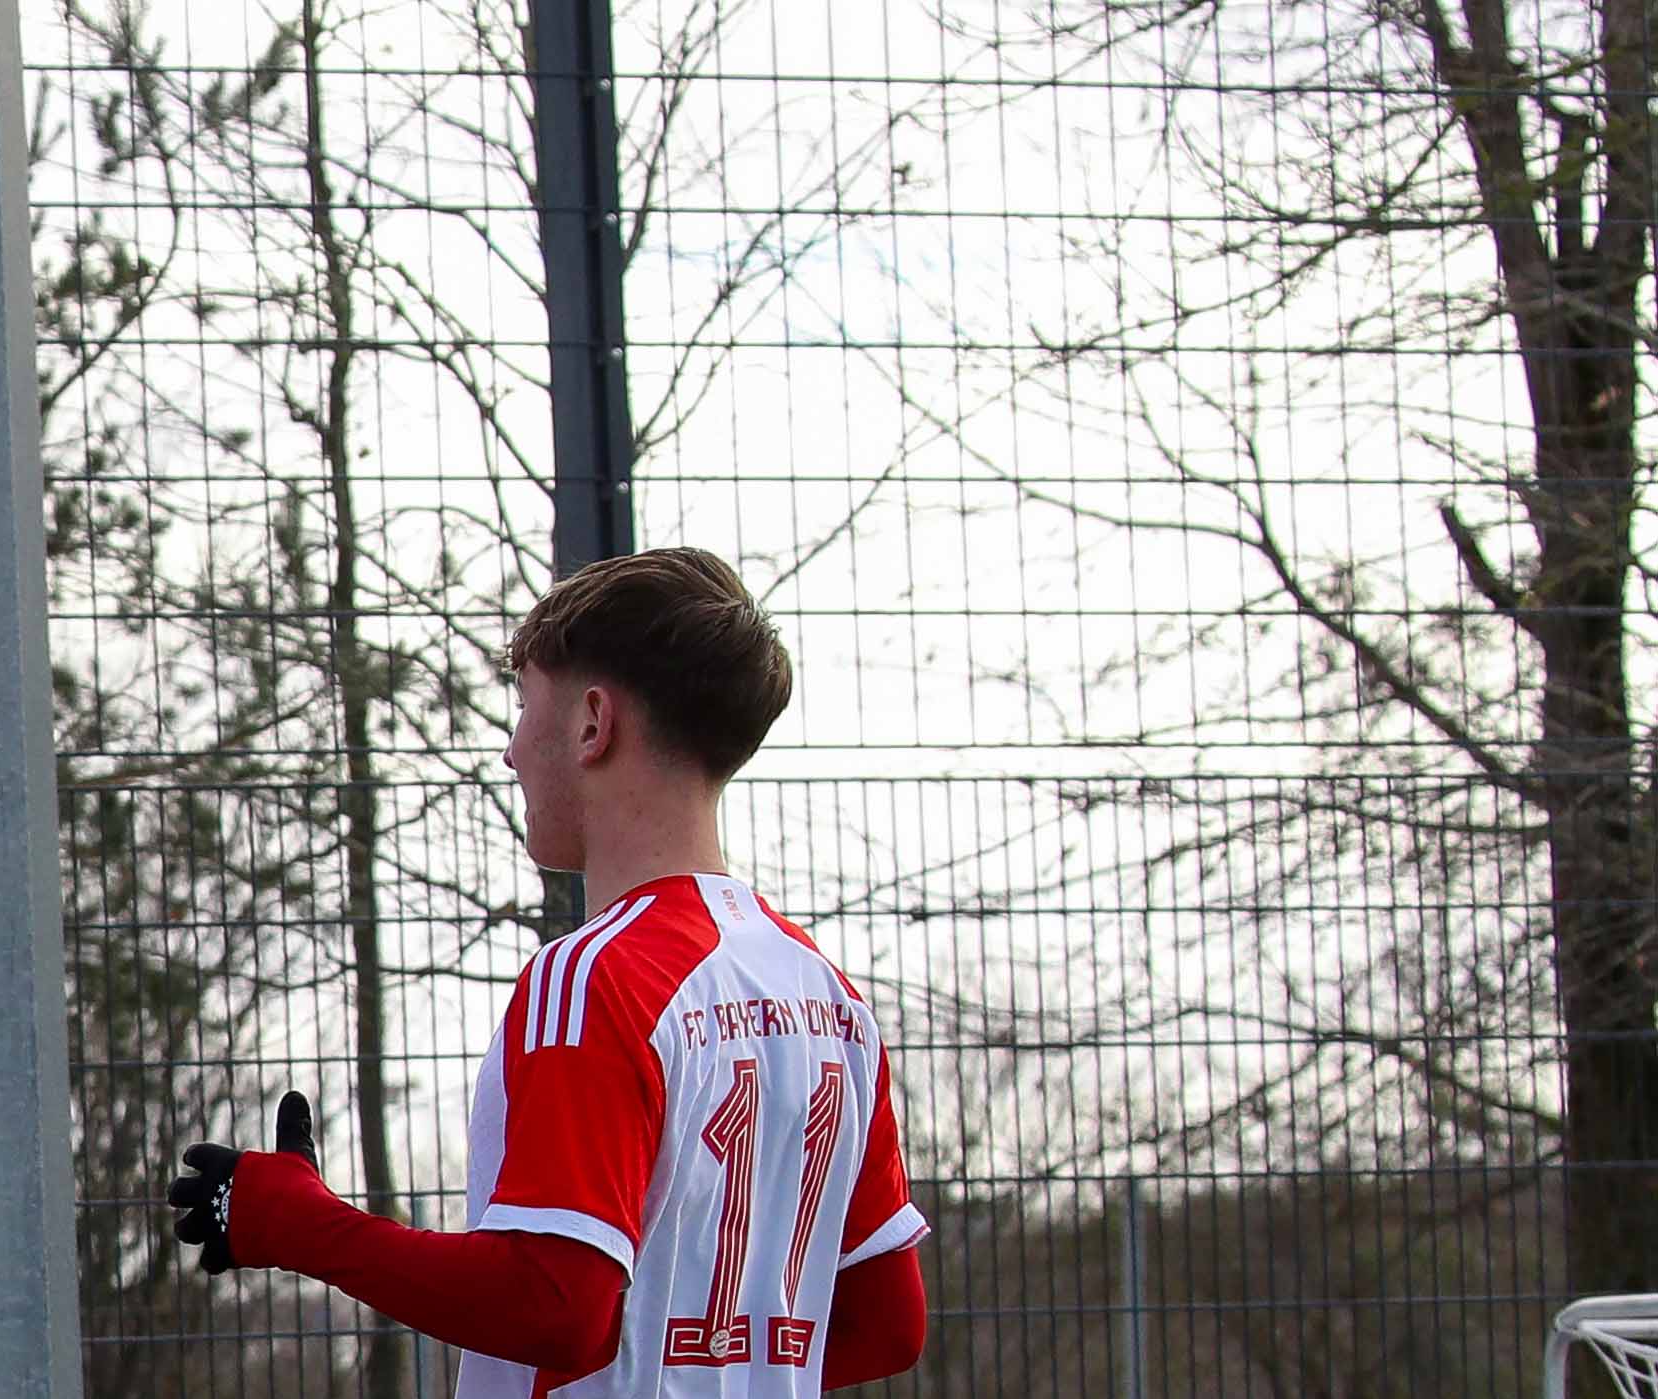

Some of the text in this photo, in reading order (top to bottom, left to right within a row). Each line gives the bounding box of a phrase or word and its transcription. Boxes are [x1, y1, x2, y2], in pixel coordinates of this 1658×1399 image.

[683, 1009, 708, 1051] FC
[714, 999, 799, 1042] BAYERN
[662, 1058, 844, 1368] 11
